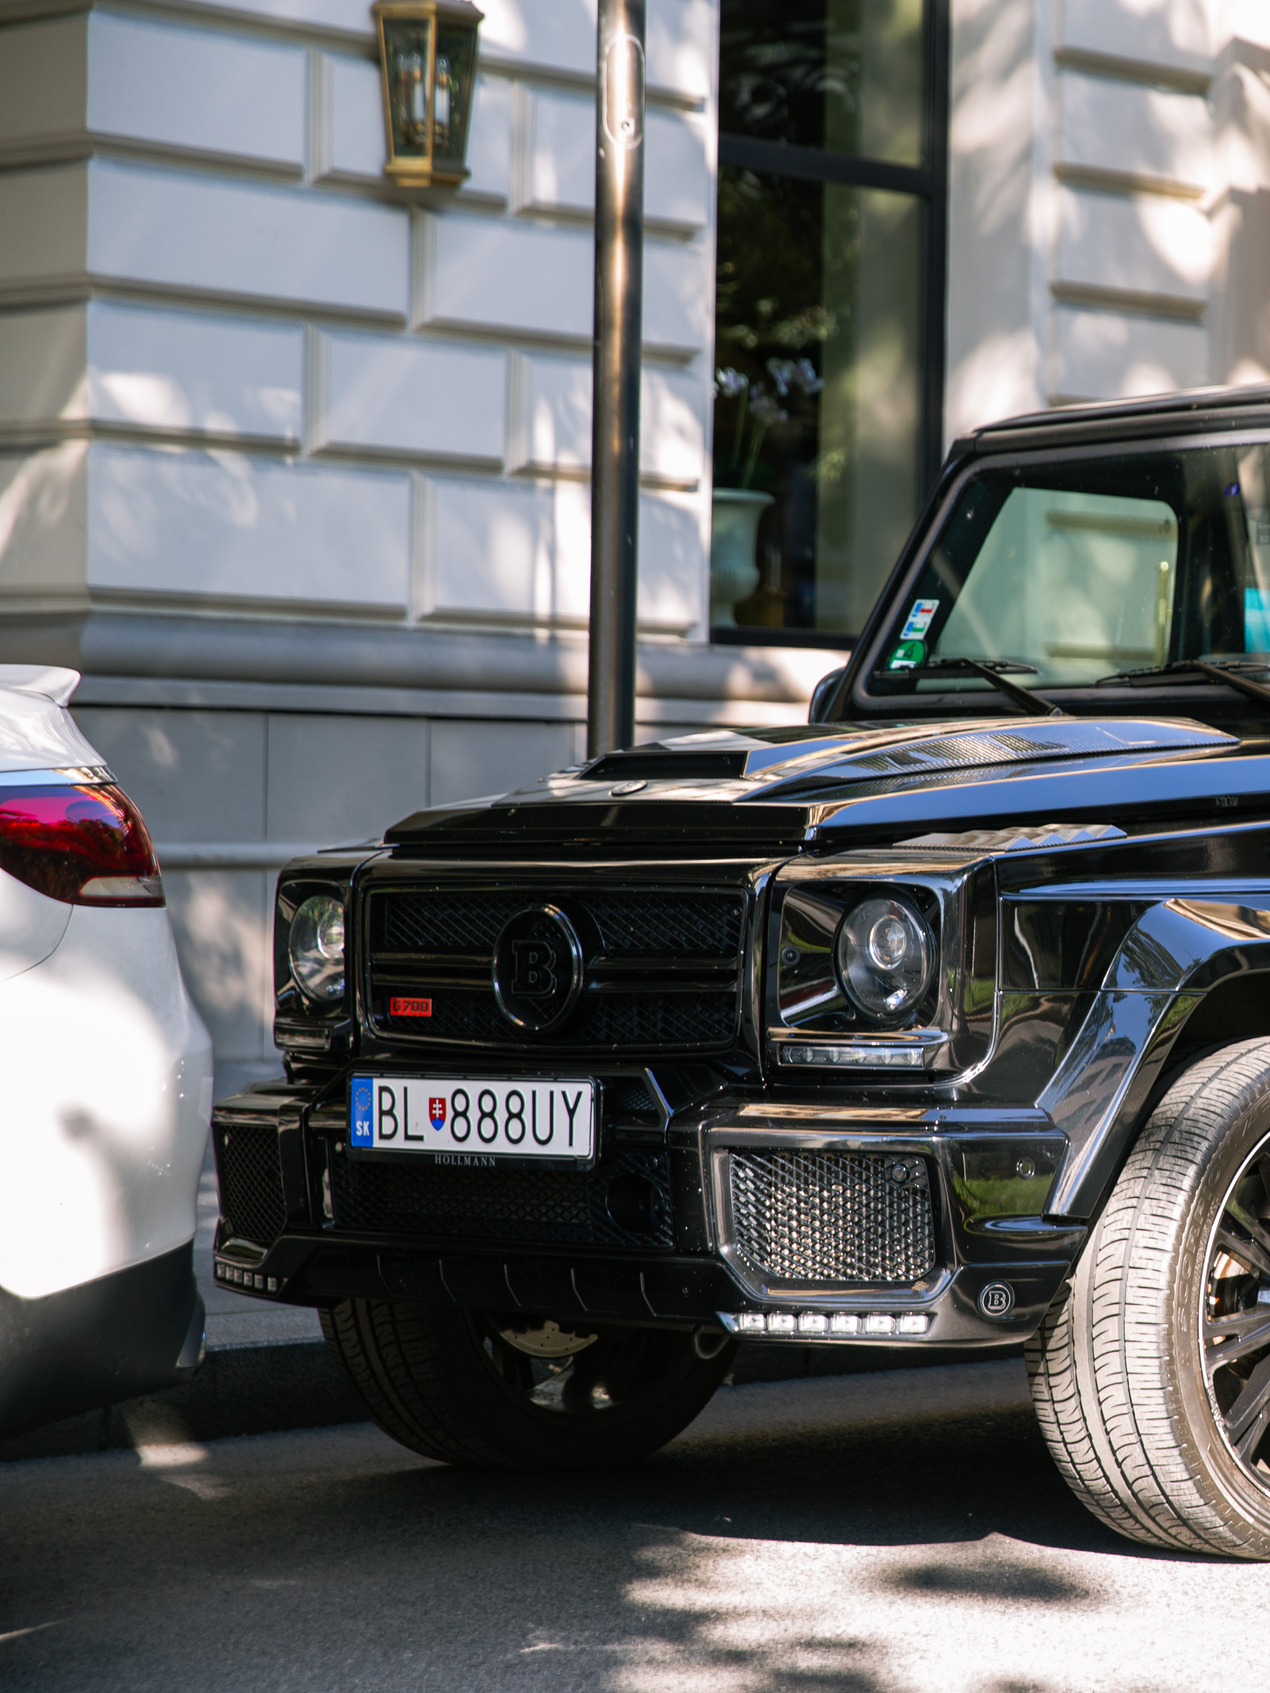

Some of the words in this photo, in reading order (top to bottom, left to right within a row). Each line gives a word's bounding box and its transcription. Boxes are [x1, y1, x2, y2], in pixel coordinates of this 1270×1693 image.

[378, 1085, 424, 1142] BL
[450, 1088, 583, 1147] 888UY
[356, 1121, 370, 1137] SK
[434, 1154, 496, 1167] HOLLMANN
[988, 1290, 1007, 1310] B
